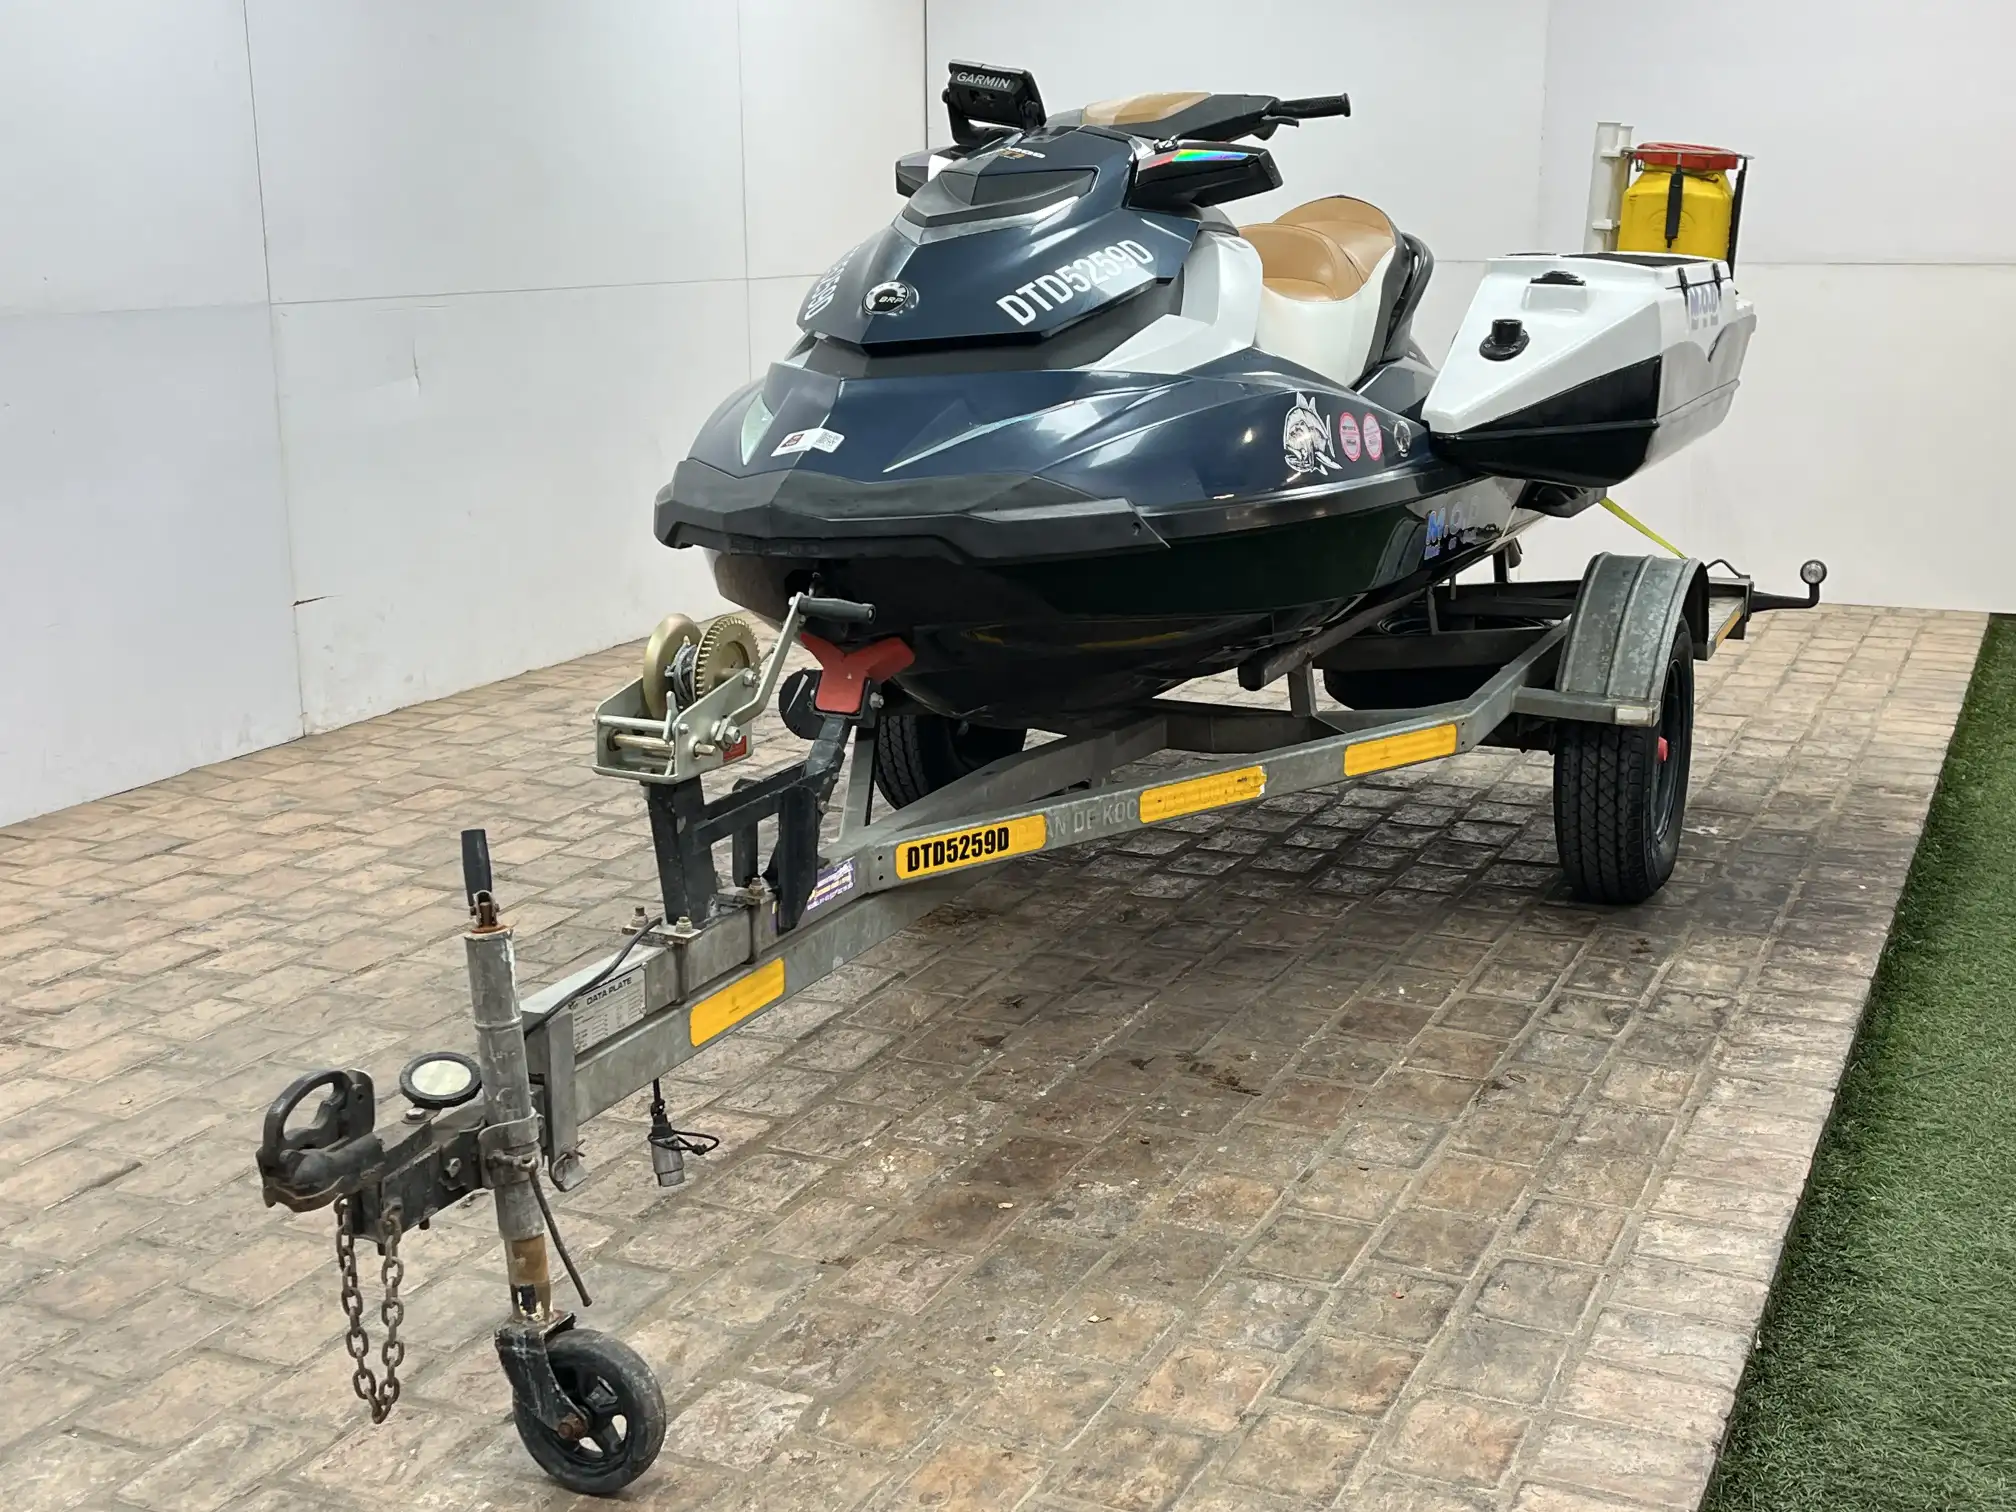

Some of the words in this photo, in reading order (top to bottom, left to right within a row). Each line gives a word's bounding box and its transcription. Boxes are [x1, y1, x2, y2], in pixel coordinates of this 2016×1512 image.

[957, 72, 1011, 89] GARMIN
[996, 240, 1154, 326] DTD5259D
[879, 296, 904, 304] BRP
[907, 827, 1009, 872] DTD5259D
[586, 990, 608, 1005] DATA
[609, 977, 632, 994] PLATE
